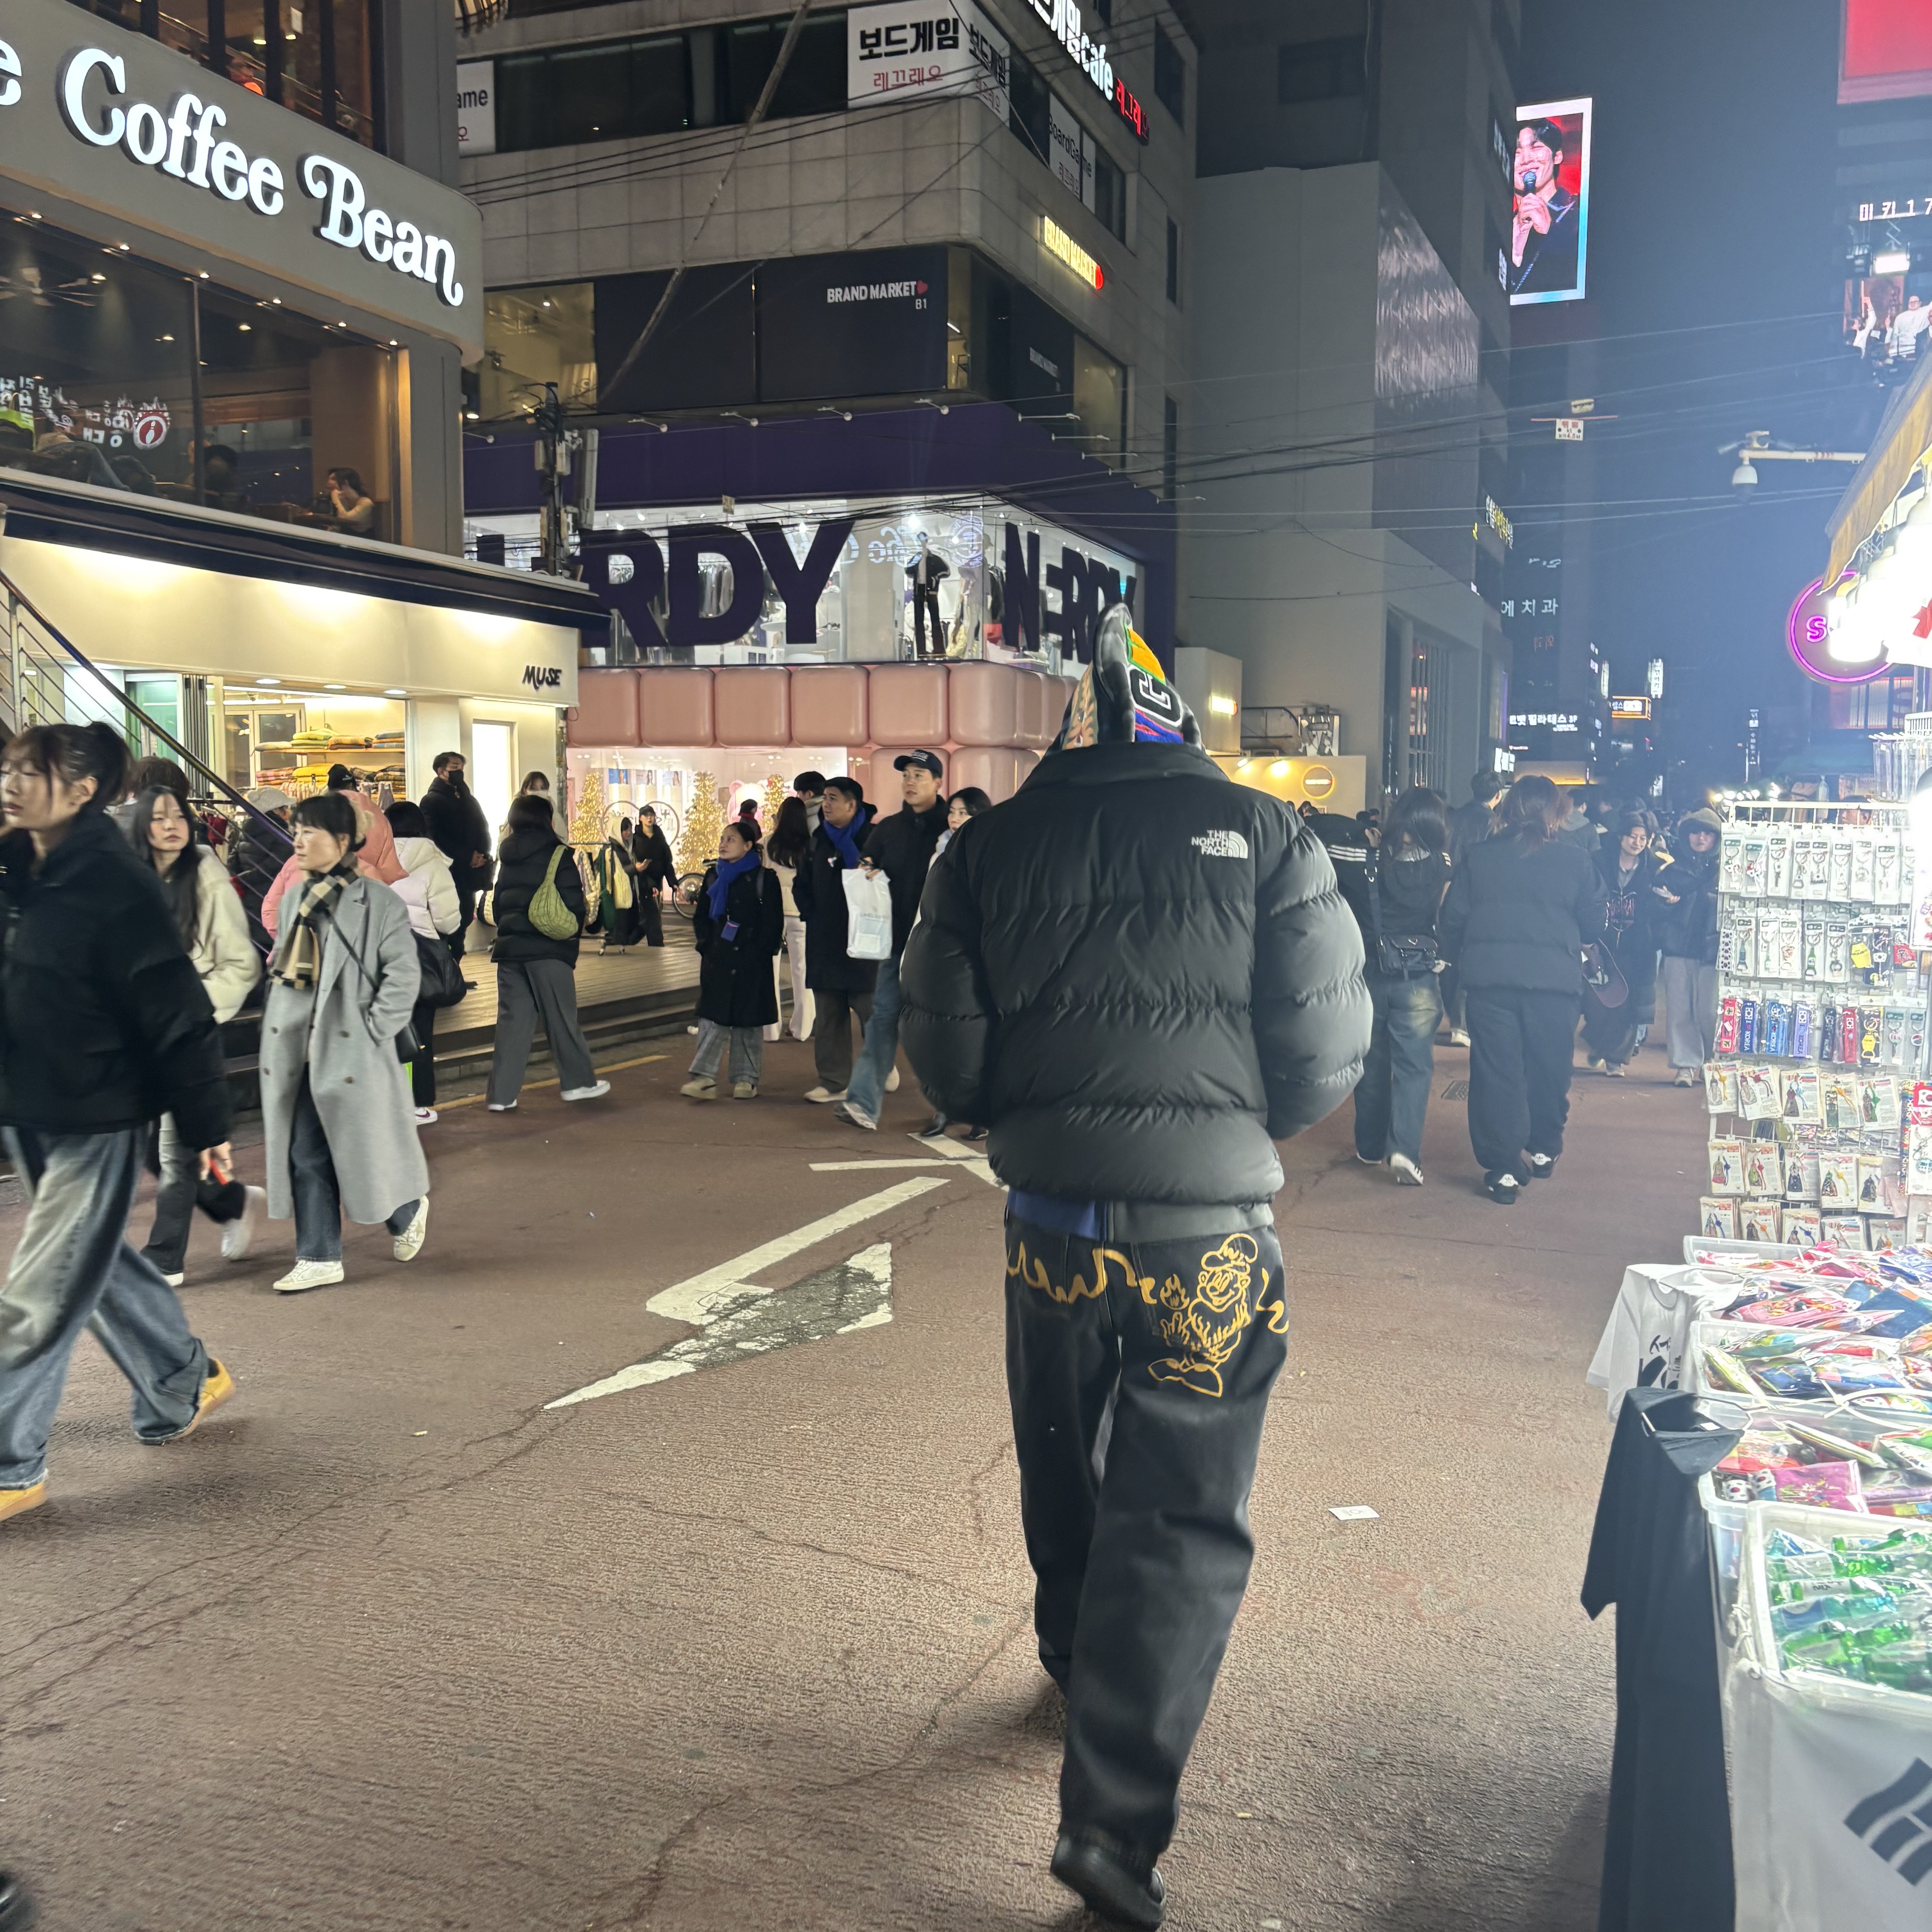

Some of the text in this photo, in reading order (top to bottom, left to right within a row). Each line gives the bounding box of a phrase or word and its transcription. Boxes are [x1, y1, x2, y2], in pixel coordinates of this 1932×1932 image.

[859, 18, 959, 61] 보드게임
[874, 65, 944, 91] 레끄레오
[64, 48, 284, 216] Coffee
[303, 155, 463, 307] Bean
[827, 281, 917, 303] BRAND MARKET
[915, 298, 927, 309] B1
[477, 519, 856, 648] RDY
[522, 665, 562, 690] MUSE
[1191, 837, 1228, 847] NORTH
[1207, 830, 1228, 839] THE
[1201, 845, 1228, 856] FACE
